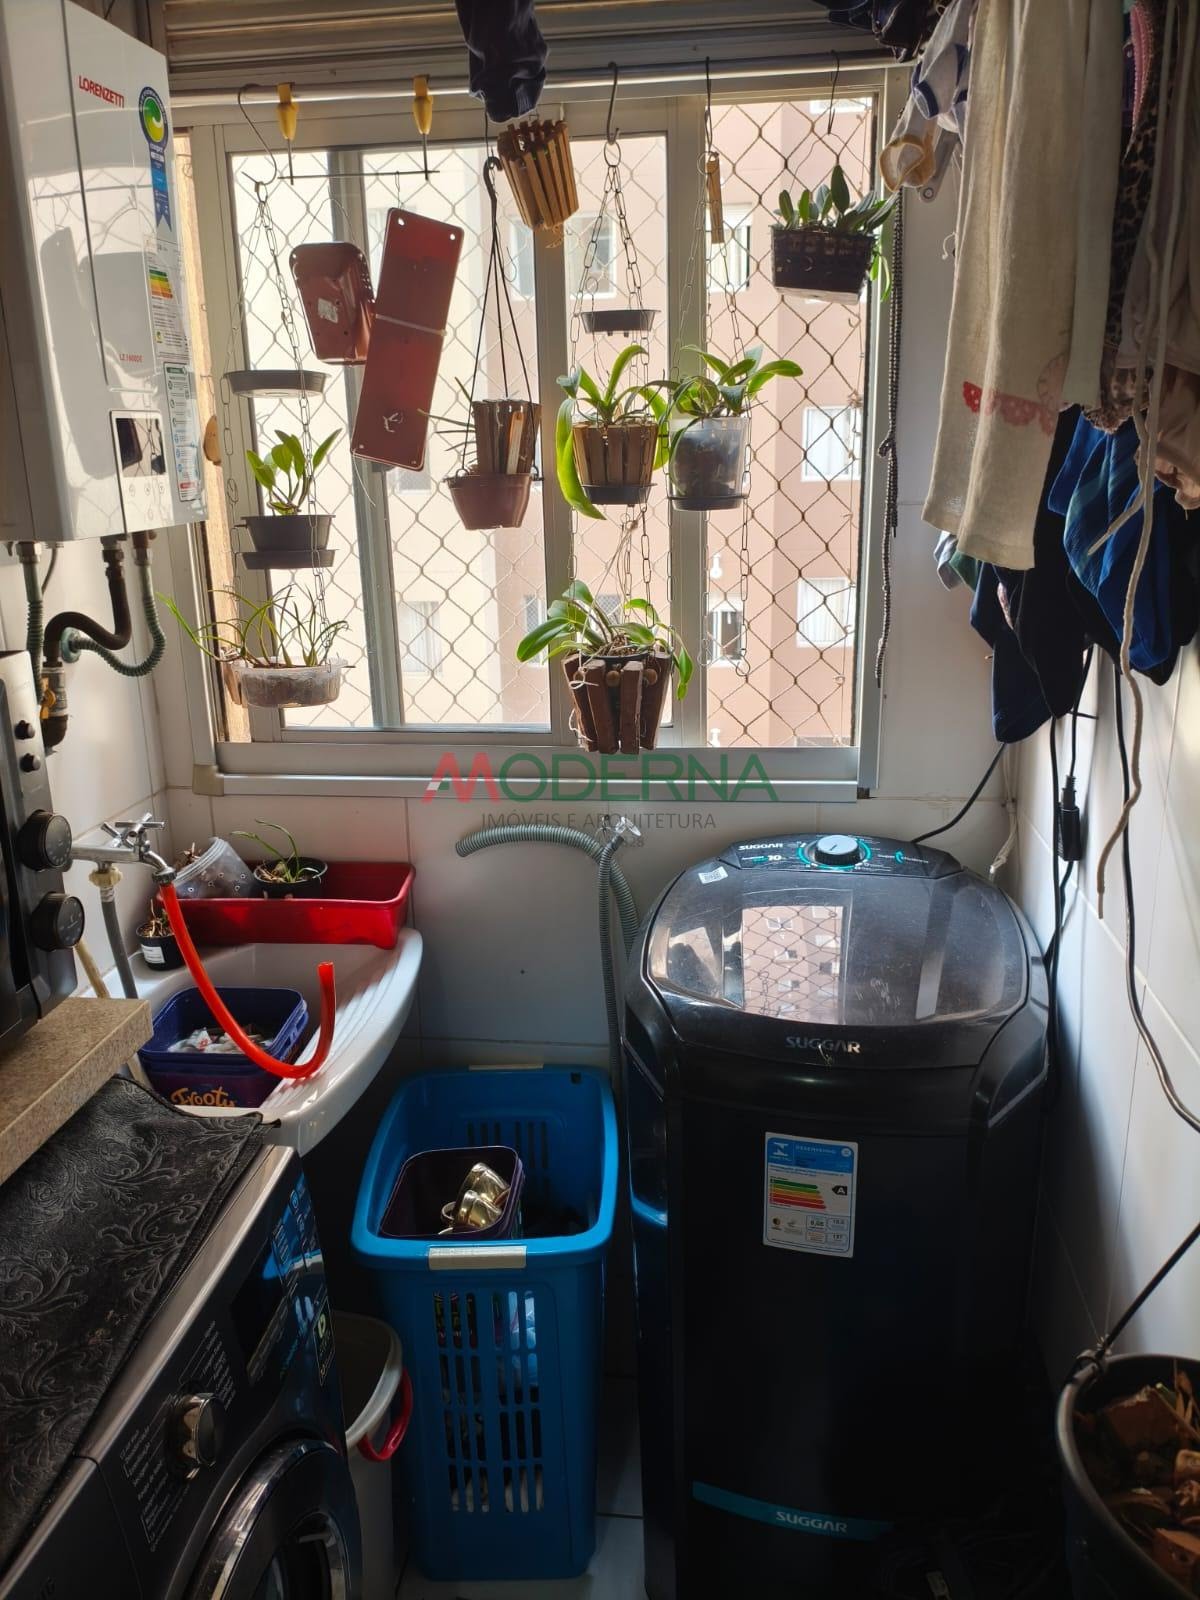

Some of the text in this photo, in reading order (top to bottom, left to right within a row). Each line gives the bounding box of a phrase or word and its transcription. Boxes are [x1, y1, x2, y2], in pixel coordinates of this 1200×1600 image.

[78, 75, 125, 109] LORENZETTI
[738, 842, 784, 851] SUGGAR
[785, 1036, 861, 1053] SUGGAR
[775, 1511, 848, 1533] SUGGAR
